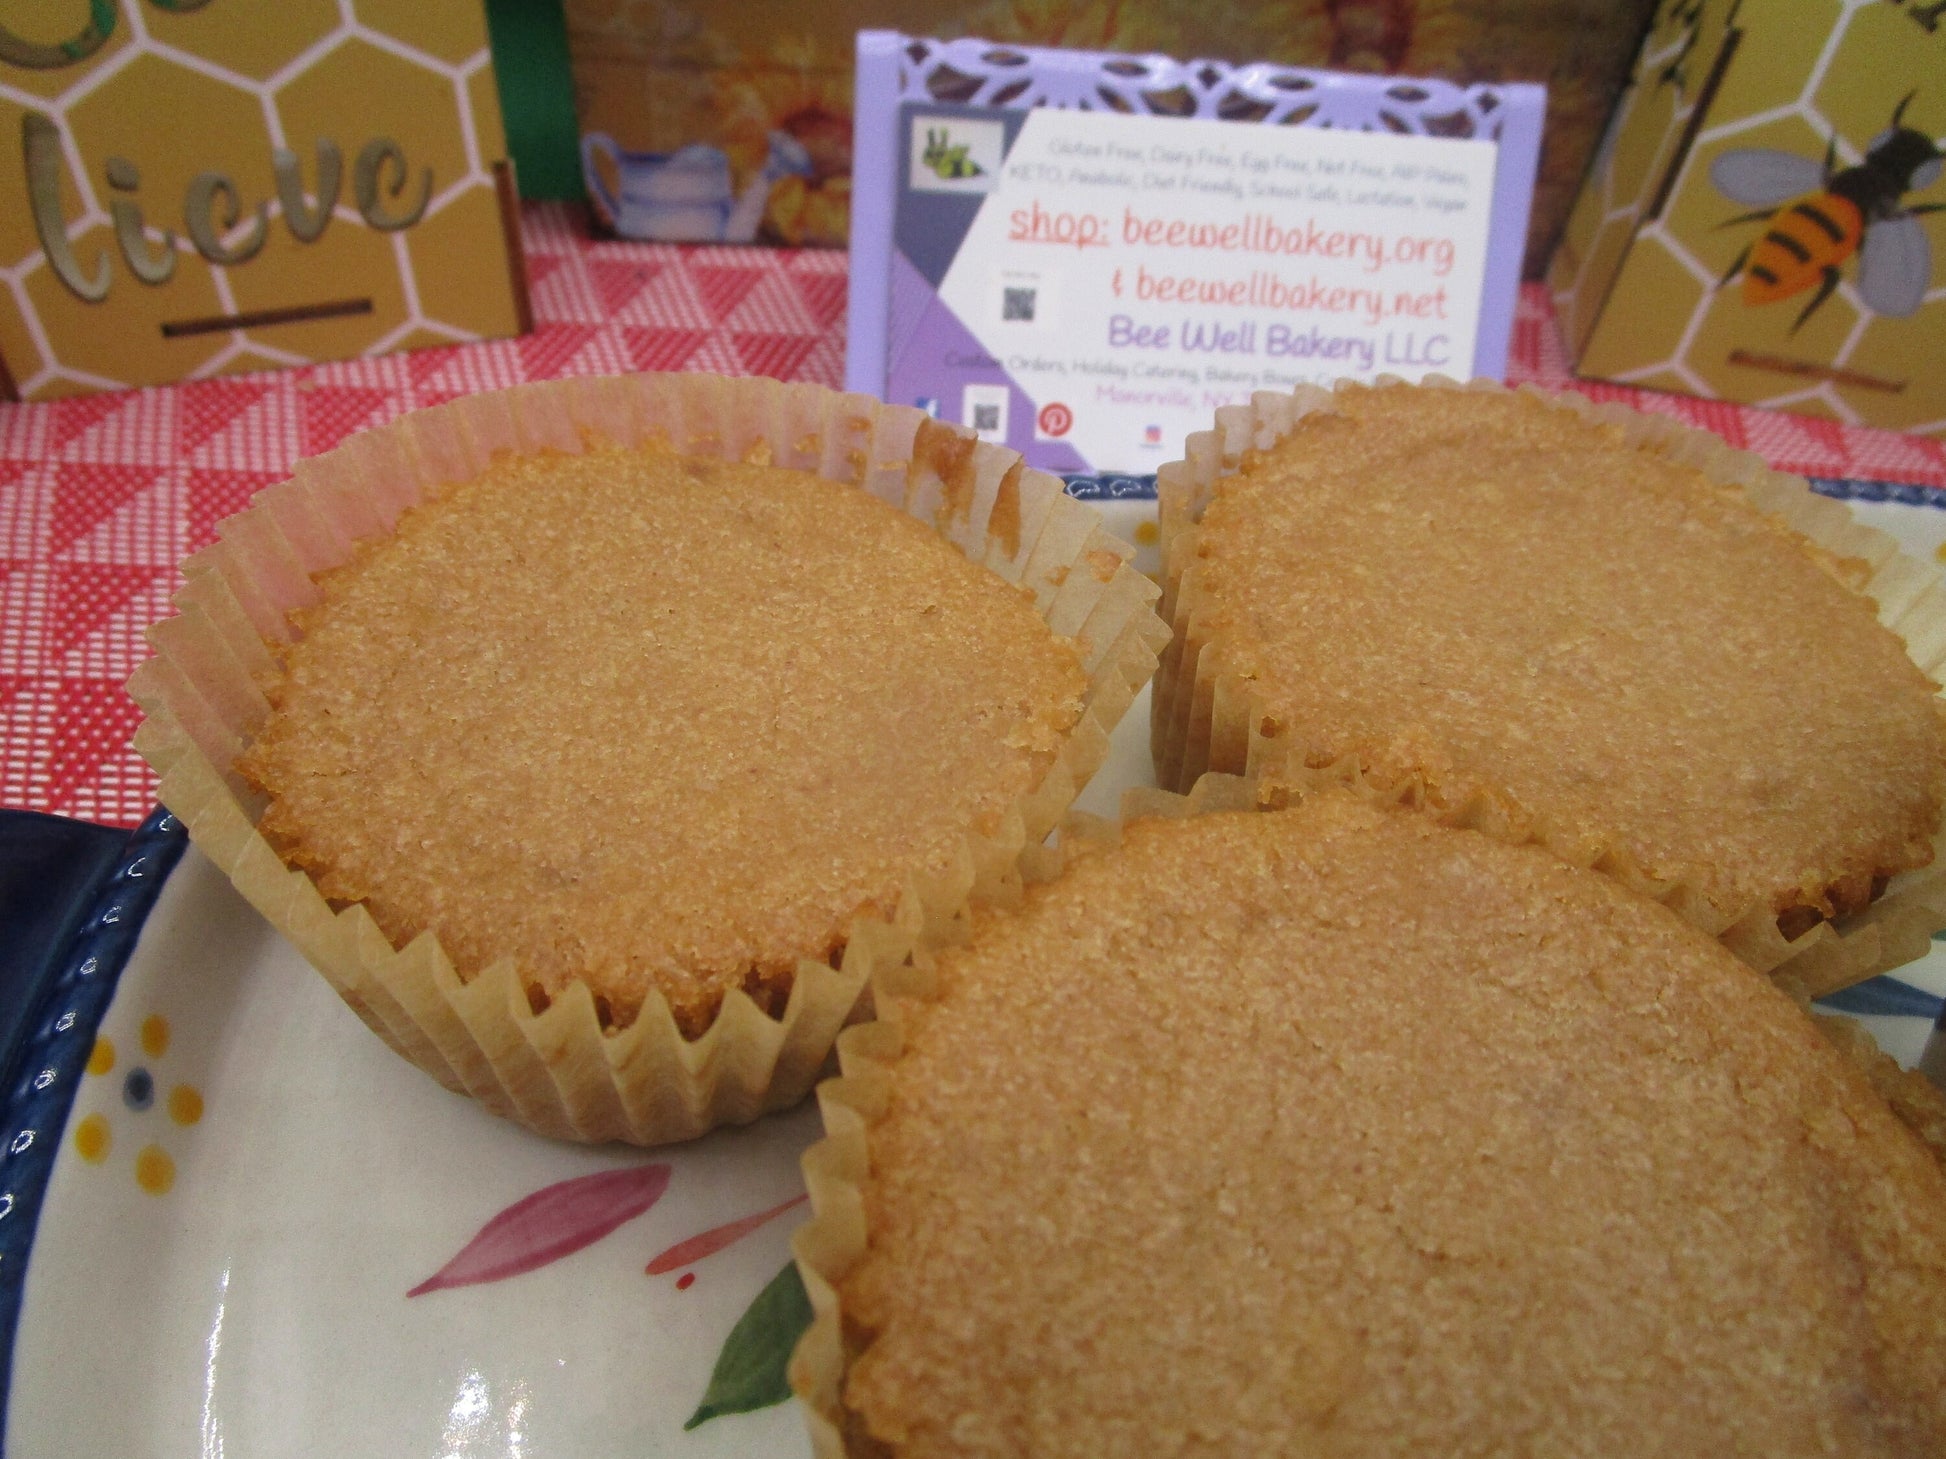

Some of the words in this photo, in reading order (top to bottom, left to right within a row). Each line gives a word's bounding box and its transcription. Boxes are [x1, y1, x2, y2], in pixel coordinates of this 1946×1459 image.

[1008, 200, 1110, 250] shop:
[1121, 205, 1457, 278] beewellbakery.org
[1136, 264, 1449, 327] beewellbakery.net
[1108, 314, 1170, 348] Bee
[1179, 318, 1257, 353] Well
[1265, 323, 1375, 370] Bakery
[1384, 331, 1451, 366] LLC
